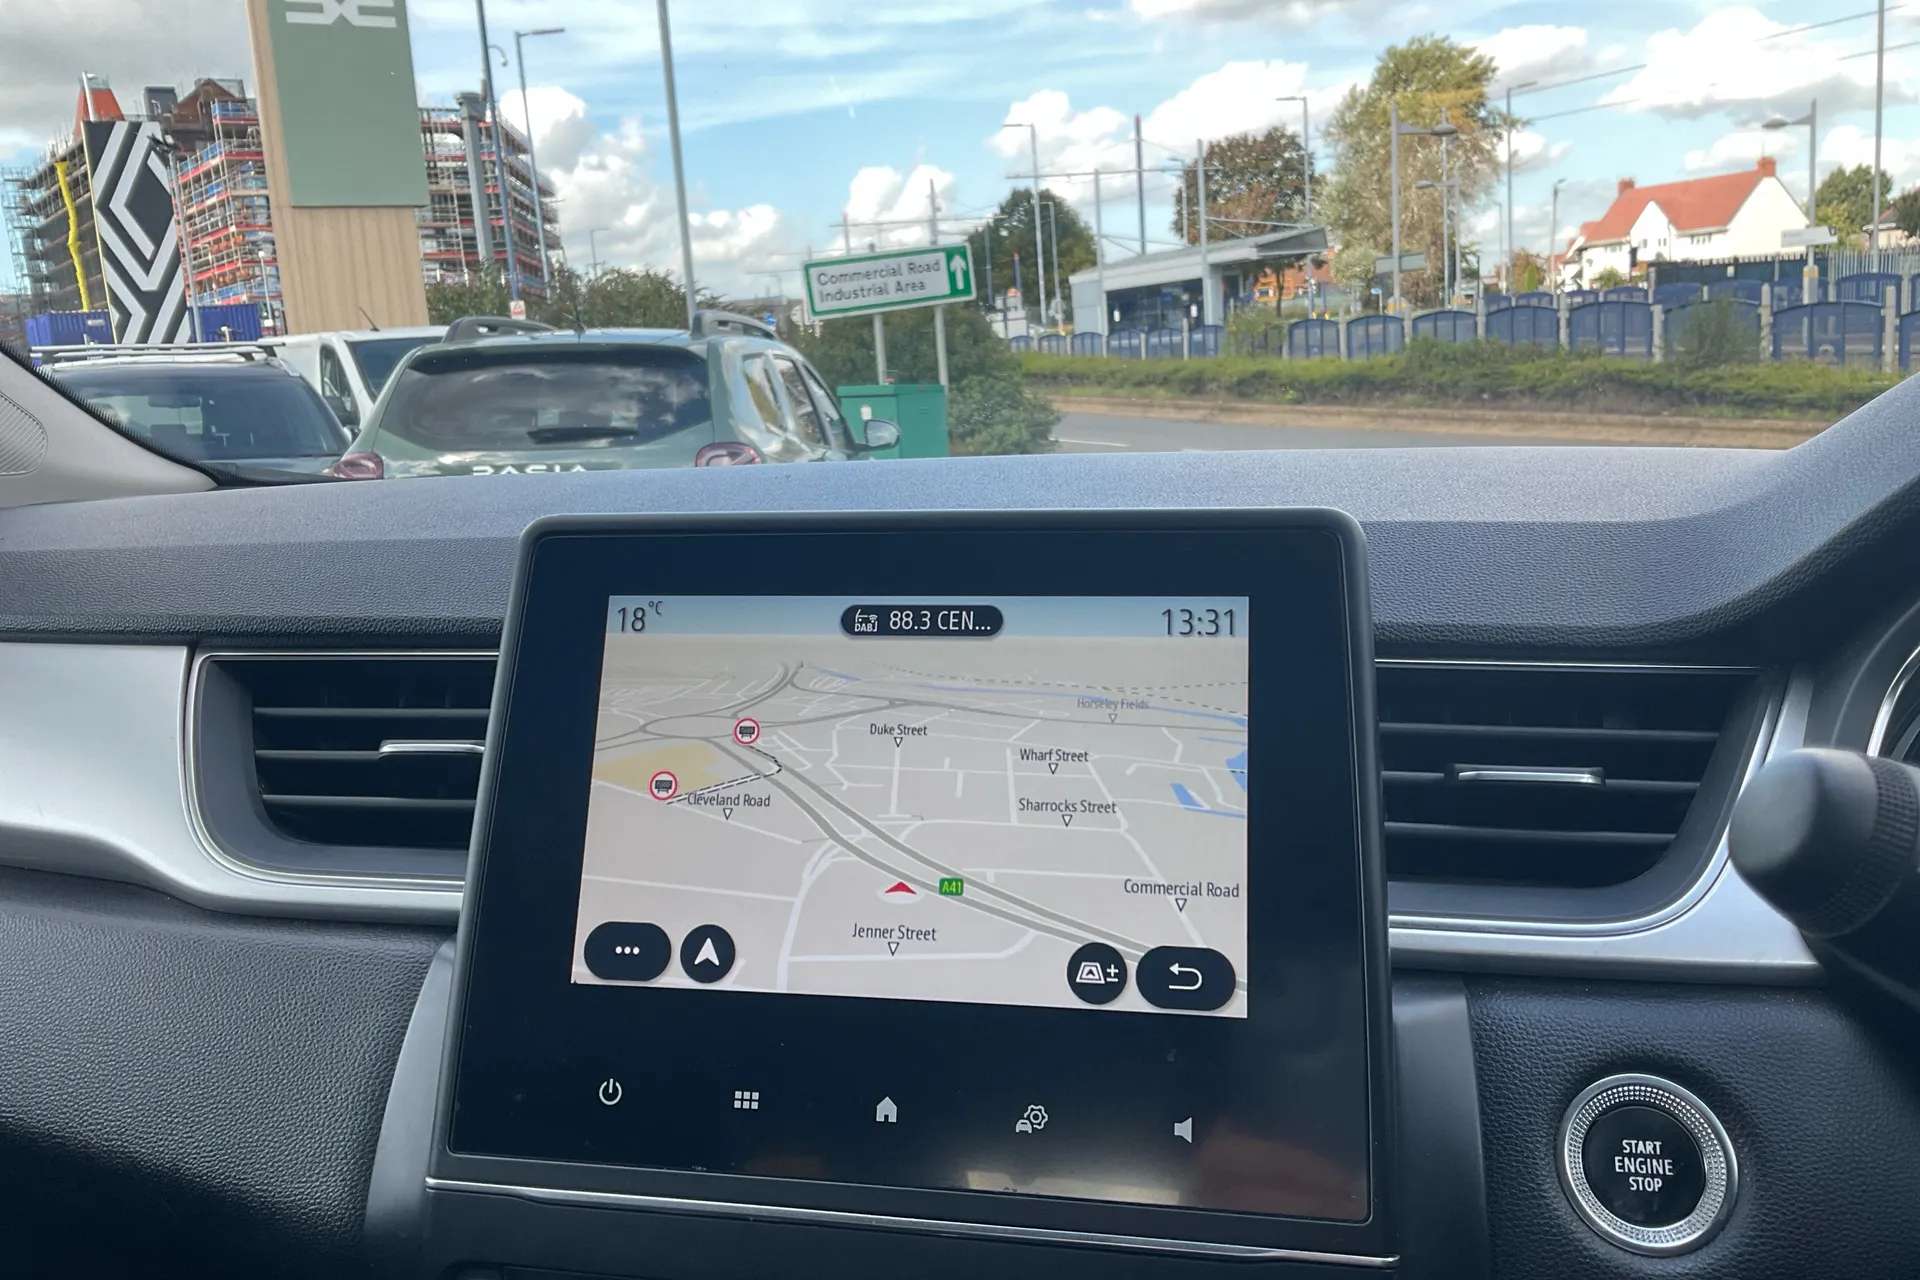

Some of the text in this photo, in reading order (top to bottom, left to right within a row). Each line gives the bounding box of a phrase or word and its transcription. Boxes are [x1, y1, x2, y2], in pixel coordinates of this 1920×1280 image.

[816, 259, 941, 286] Commercial Road
[819, 279, 927, 303] Industrial Area
[889, 610, 931, 630] 88.3
[937, 610, 991, 630] CEN...
[1161, 608, 1234, 636] 13:31
[1120, 698, 1150, 710] Fields
[870, 723, 928, 736] Duke Street
[1020, 748, 1089, 762] Wharf Street
[687, 792, 771, 807] Cleveland Road
[1018, 797, 1118, 814] Sharrocks Street
[942, 881, 961, 893] A41
[1123, 878, 1240, 898] Commercial Road
[852, 922, 937, 941] Jenner Street
[1622, 1139, 1662, 1155] START
[1614, 1156, 1674, 1176] ENGINE
[1628, 1176, 1663, 1192] STOP
